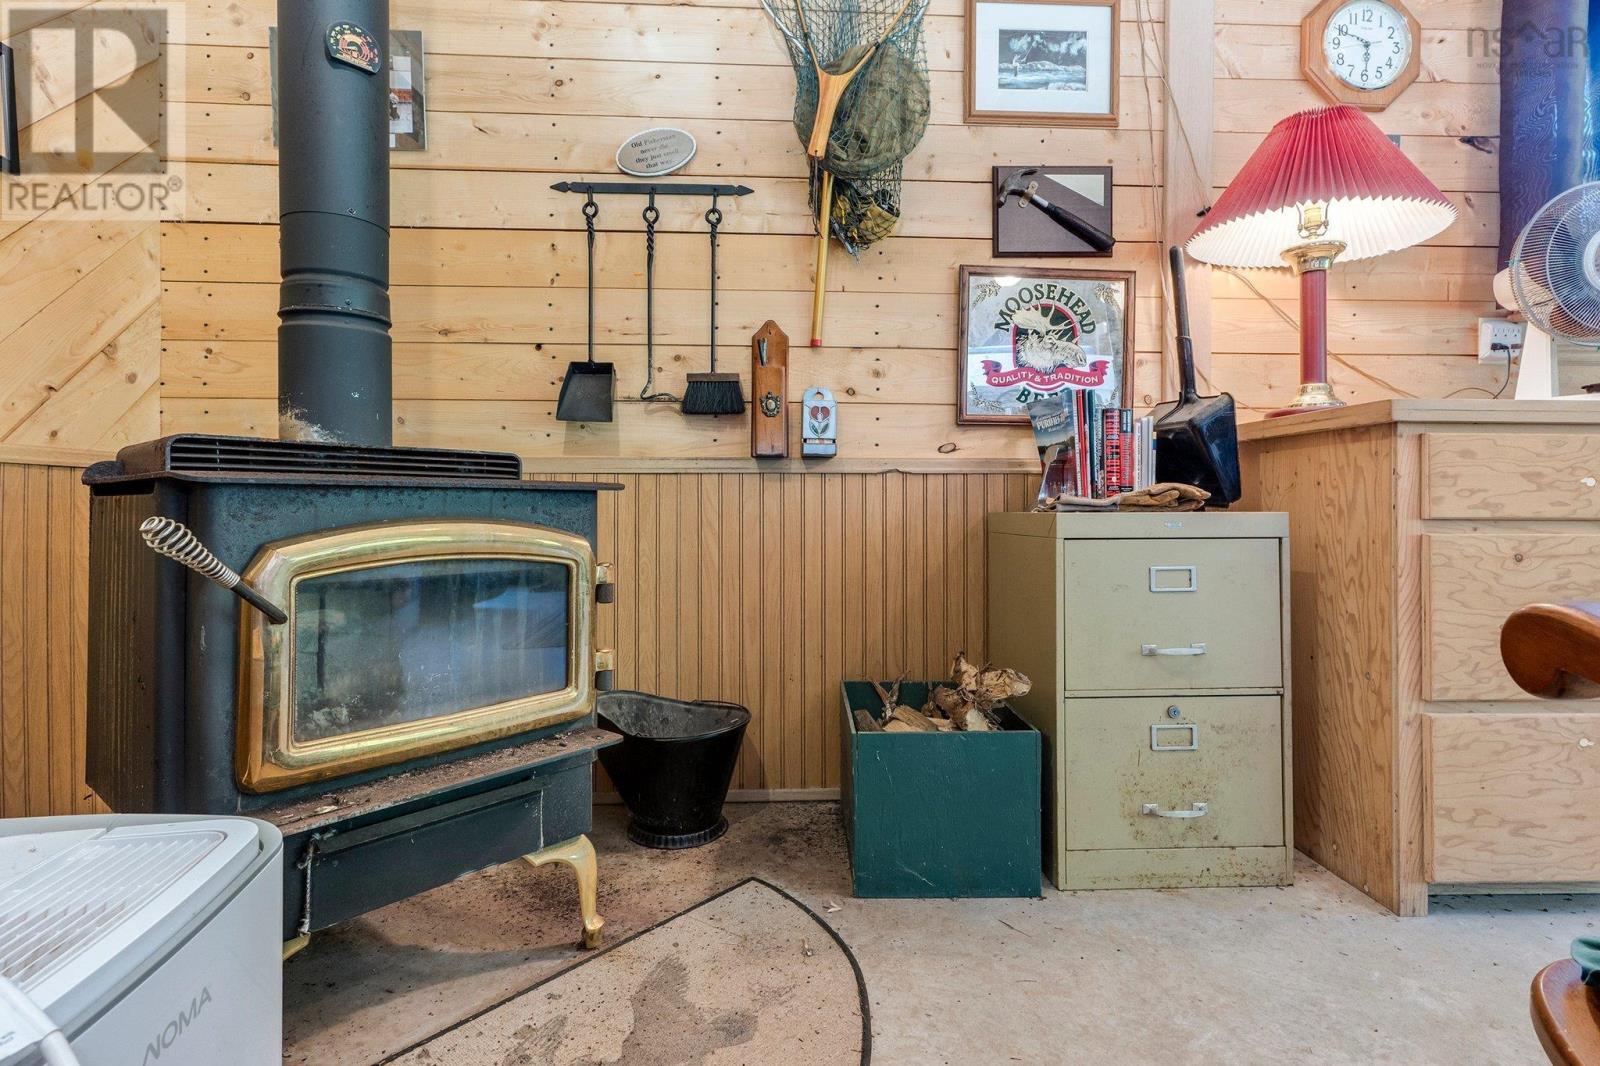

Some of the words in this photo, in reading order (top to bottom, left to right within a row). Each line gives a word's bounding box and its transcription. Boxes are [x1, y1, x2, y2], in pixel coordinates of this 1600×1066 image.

[1349, 13, 1358, 25] 11
[1362, 9, 1374, 22] 12
[1379, 15, 1383, 28] 1
[1338, 24, 1348, 36] 10
[1387, 26, 1395, 39] 2
[1332, 36, 1341, 50] 9
[1392, 41, 1400, 54] 3
[1336, 53, 1345, 65] 8
[1385, 56, 1393, 69] 4
[1347, 64, 1355, 78] 7
[1360, 70, 1369, 82] 6
[1375, 66, 1383, 79] 5
[994, 283, 1096, 334] MOOSEHEAD
[991, 371, 1034, 384] QUALITY
[1043, 373, 1099, 384] TRADITION
[142, 985, 213, 1066] NOMA
